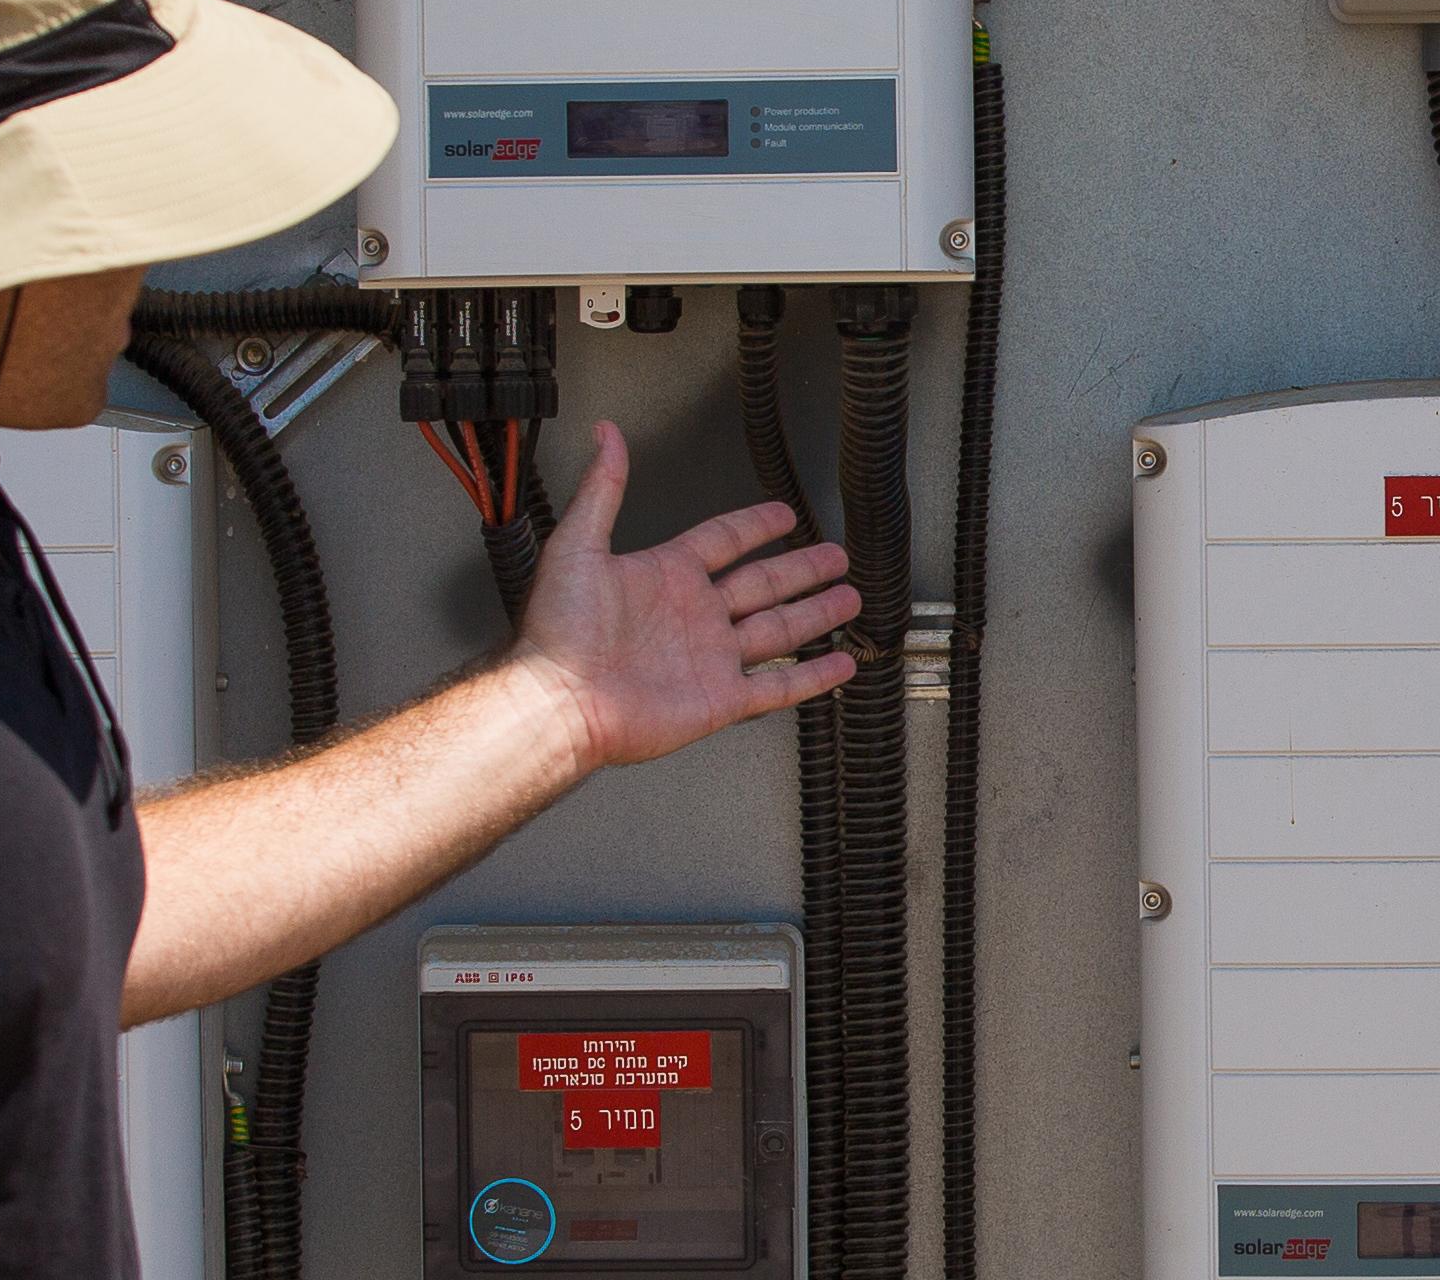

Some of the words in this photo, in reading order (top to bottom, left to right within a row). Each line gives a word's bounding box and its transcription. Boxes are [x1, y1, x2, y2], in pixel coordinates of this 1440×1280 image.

[443, 109, 534, 120] www.solaredge.com
[764, 107, 792, 116] Power
[794, 107, 840, 117] production
[764, 123, 797, 132] Module
[798, 122, 864, 132] communication
[764, 138, 787, 148] Fault
[1391, 496, 1404, 517] 5
[454, 973, 481, 983] ABB
[505, 973, 534, 982] IP65
[583, 1040, 636, 1053] זהירות!
[533, 1057, 579, 1072] מסוכן!
[587, 1057, 606, 1070] DC
[615, 1056, 647, 1069] מתח
[657, 1055, 688, 1070] קיים
[543, 1071, 605, 1087] סולארית
[614, 1072, 679, 1085] ממערכת
[570, 1110, 582, 1131] 5
[598, 1108, 655, 1130] ממיר
[1233, 1208, 1324, 1220] www.solaredge.com
